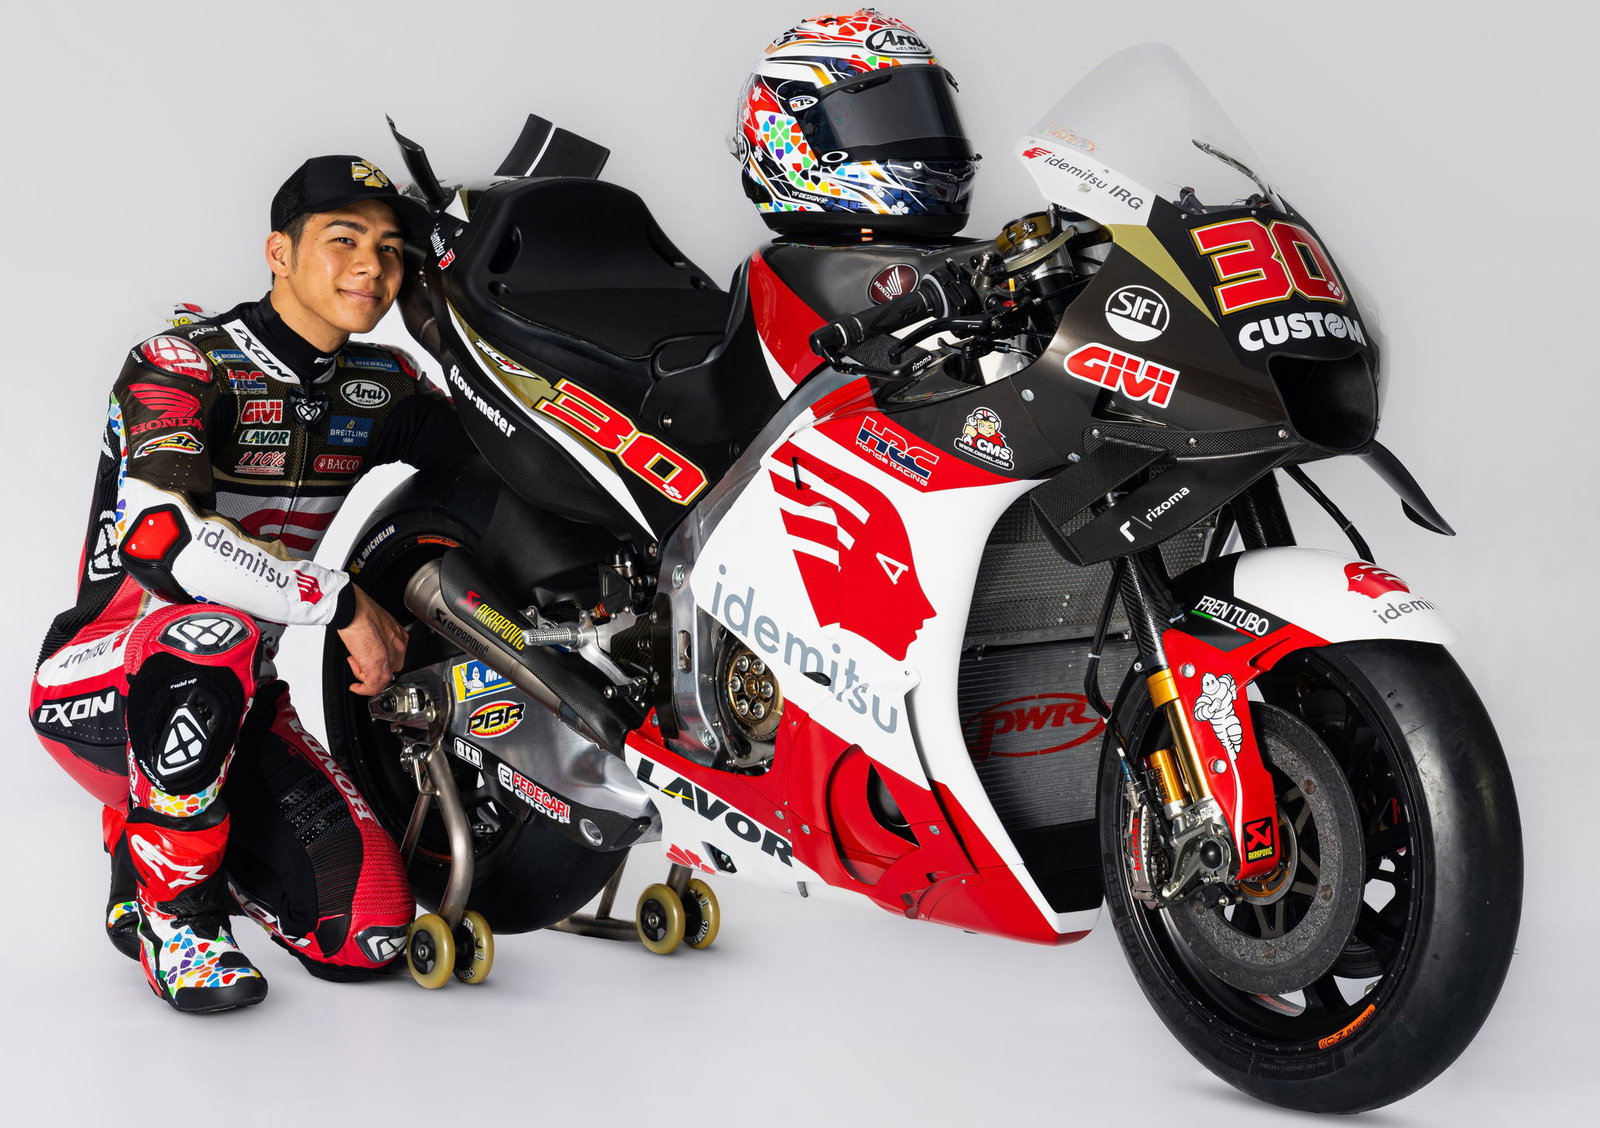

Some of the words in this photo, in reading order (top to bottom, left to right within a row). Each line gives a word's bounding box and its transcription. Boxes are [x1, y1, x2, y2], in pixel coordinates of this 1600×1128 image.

[1045, 154, 1108, 188] idemitsu
[1109, 185, 1143, 210] IRG
[1190, 217, 1347, 316] 30
[874, 280, 893, 300] HONDA
[1112, 291, 1163, 326] SIFI
[1238, 312, 1367, 351] CUSTOM
[355, 360, 392, 368] MICHELIN
[912, 354, 933, 371] rizoma
[1064, 343, 1179, 408] GIVI
[346, 384, 384, 400] Arai
[450, 365, 516, 438] flow-meter
[130, 418, 204, 435] HONDA
[241, 400, 283, 424] GIVI
[240, 431, 289, 444] LAVOR
[330, 428, 369, 438] BREITLING
[534, 378, 709, 506] 30
[857, 416, 939, 479] HRC
[977, 438, 1011, 460] CMS
[240, 451, 286, 467] 110%
[327, 459, 359, 470] BACCO
[889, 461, 928, 487] RACING
[1145, 487, 1190, 522] rizoma
[196, 523, 290, 590] idemitsu
[361, 525, 396, 559] MICHELIN
[1195, 595, 1230, 619] FREN
[1228, 608, 1270, 636] TUBO
[711, 564, 898, 733] idemitsu
[465, 703, 525, 735] PBR
[289, 718, 374, 821] HONDA
[513, 771, 570, 818] FEDEGARI
[515, 789, 570, 823] GROUP
[637, 758, 793, 868] LAVOR
